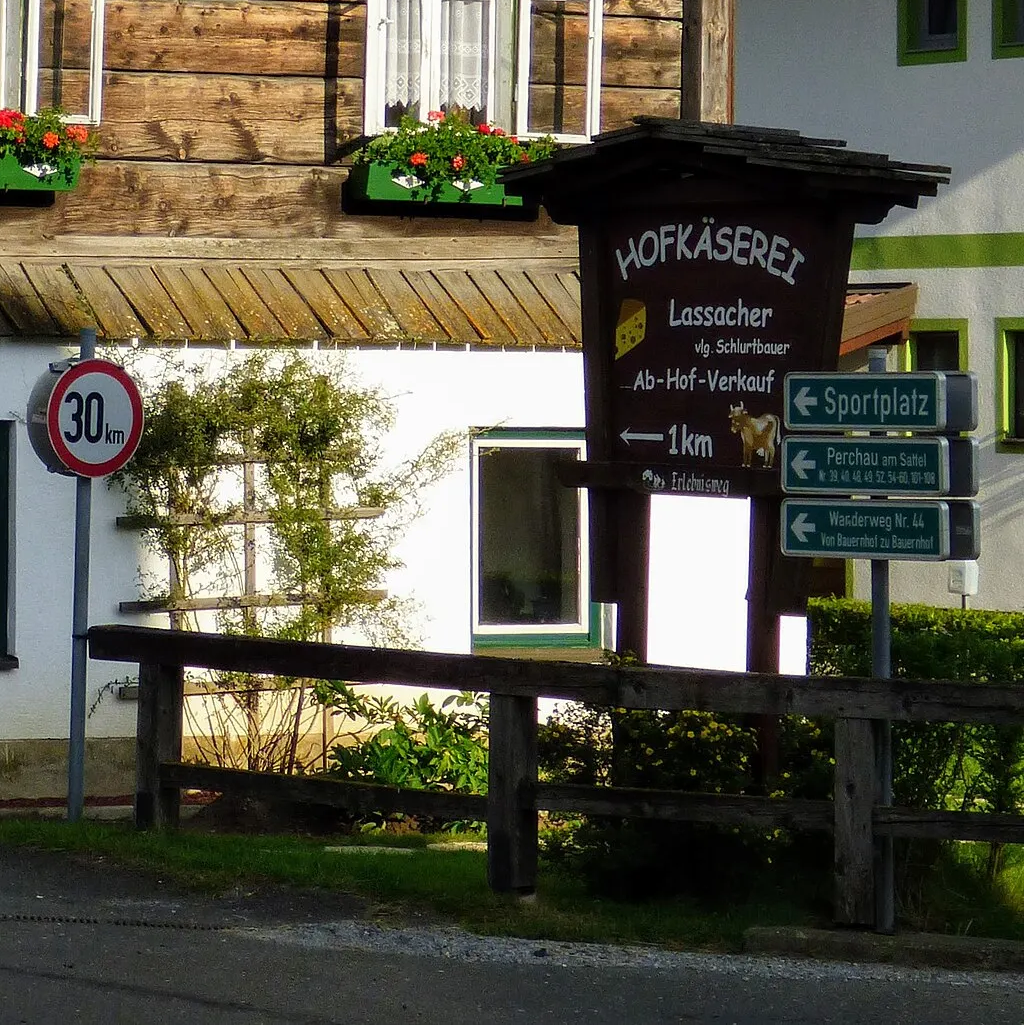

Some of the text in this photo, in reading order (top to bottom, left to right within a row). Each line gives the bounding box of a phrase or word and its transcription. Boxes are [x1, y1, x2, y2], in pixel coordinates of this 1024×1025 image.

[616, 216, 805, 285] HOFKÄSEREI
[669, 298, 773, 328] Lassacher
[695, 338, 790, 358] vlg. Schlurtbauer
[824, 386, 929, 423] Sportplatz
[827, 447, 927, 467] Perchau am Sattel
[829, 511, 925, 531] Wanderweg Nr. 44
[820, 532, 934, 549] Von Bauernhof zu Bauernhof
